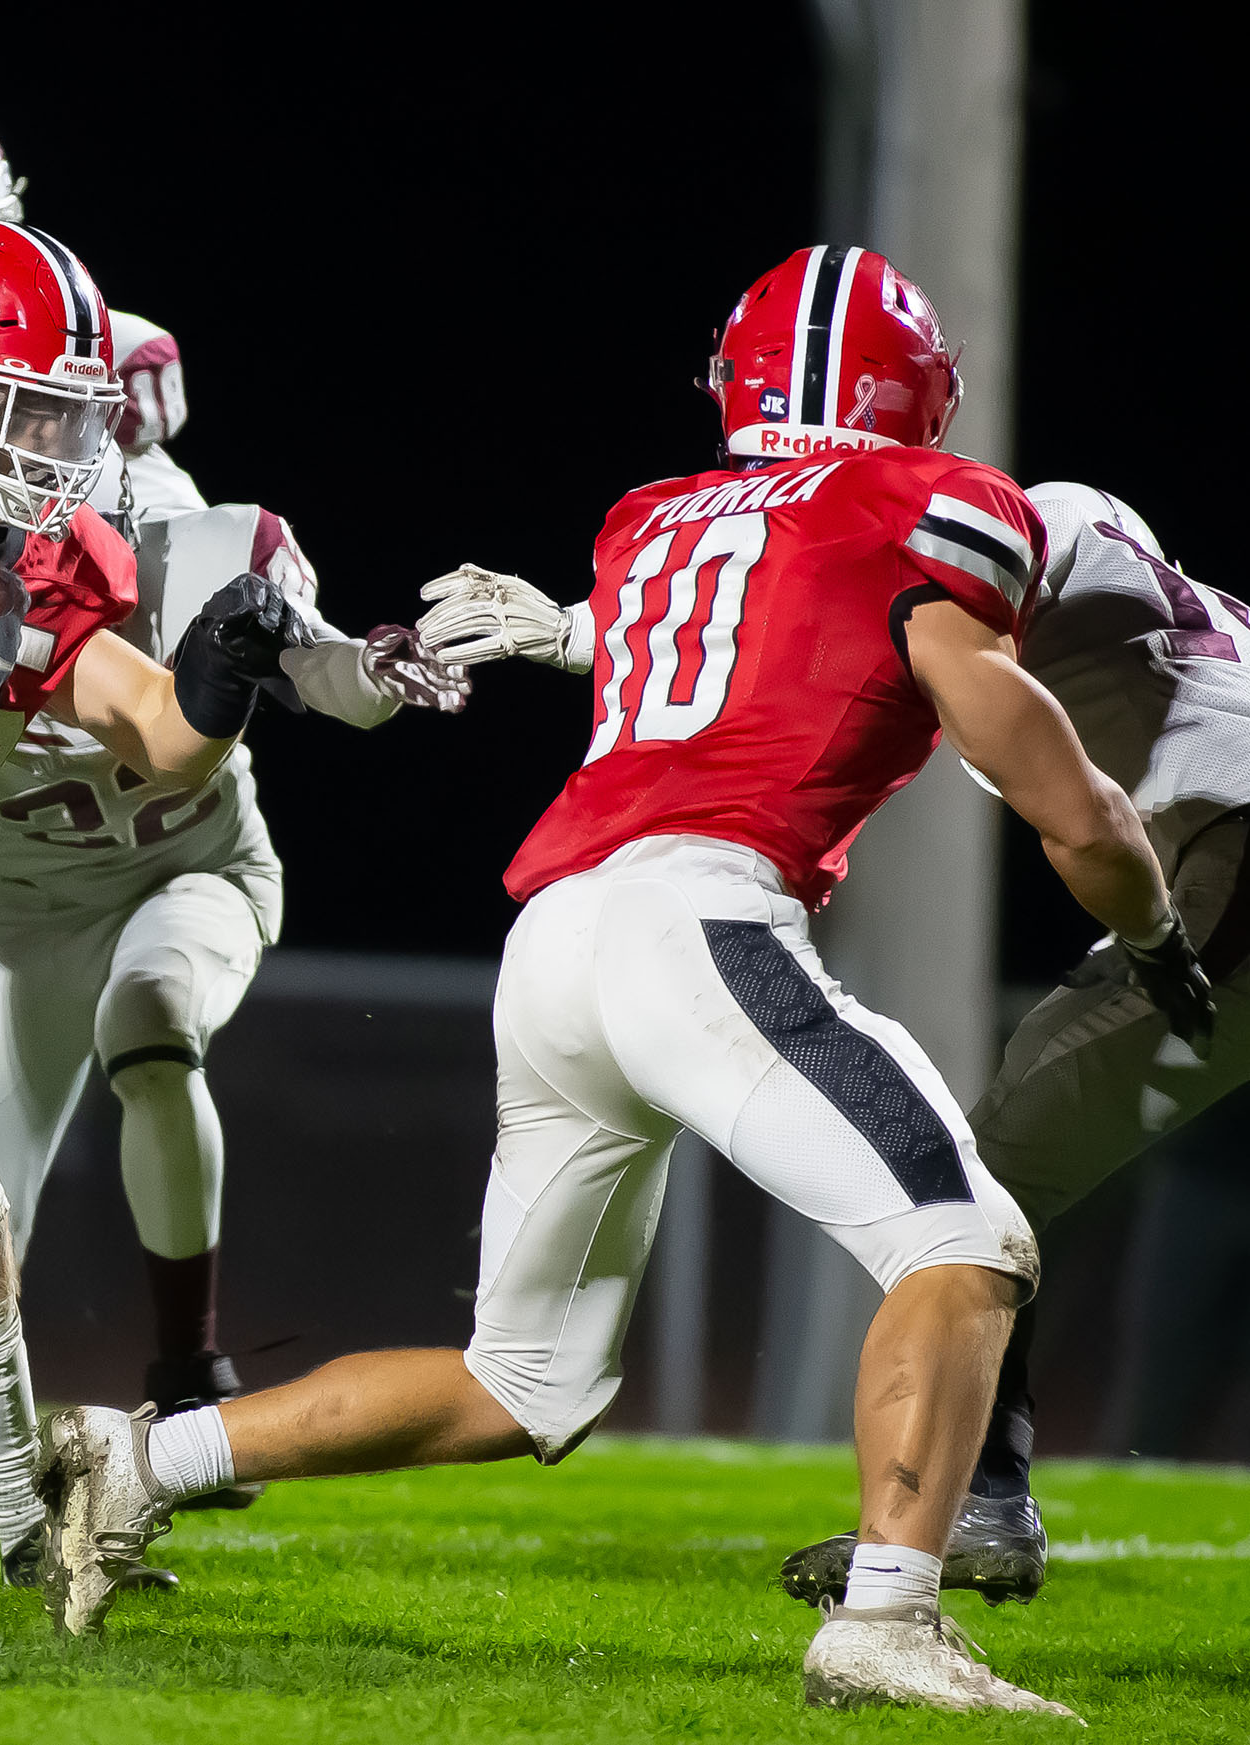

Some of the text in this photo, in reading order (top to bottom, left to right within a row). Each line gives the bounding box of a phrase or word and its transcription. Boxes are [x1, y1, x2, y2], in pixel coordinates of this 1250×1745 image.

[63, 361, 105, 377] Riddell
[760, 394, 786, 415] JK
[632, 460, 845, 541] PODRAZA
[582, 509, 770, 768] 10
